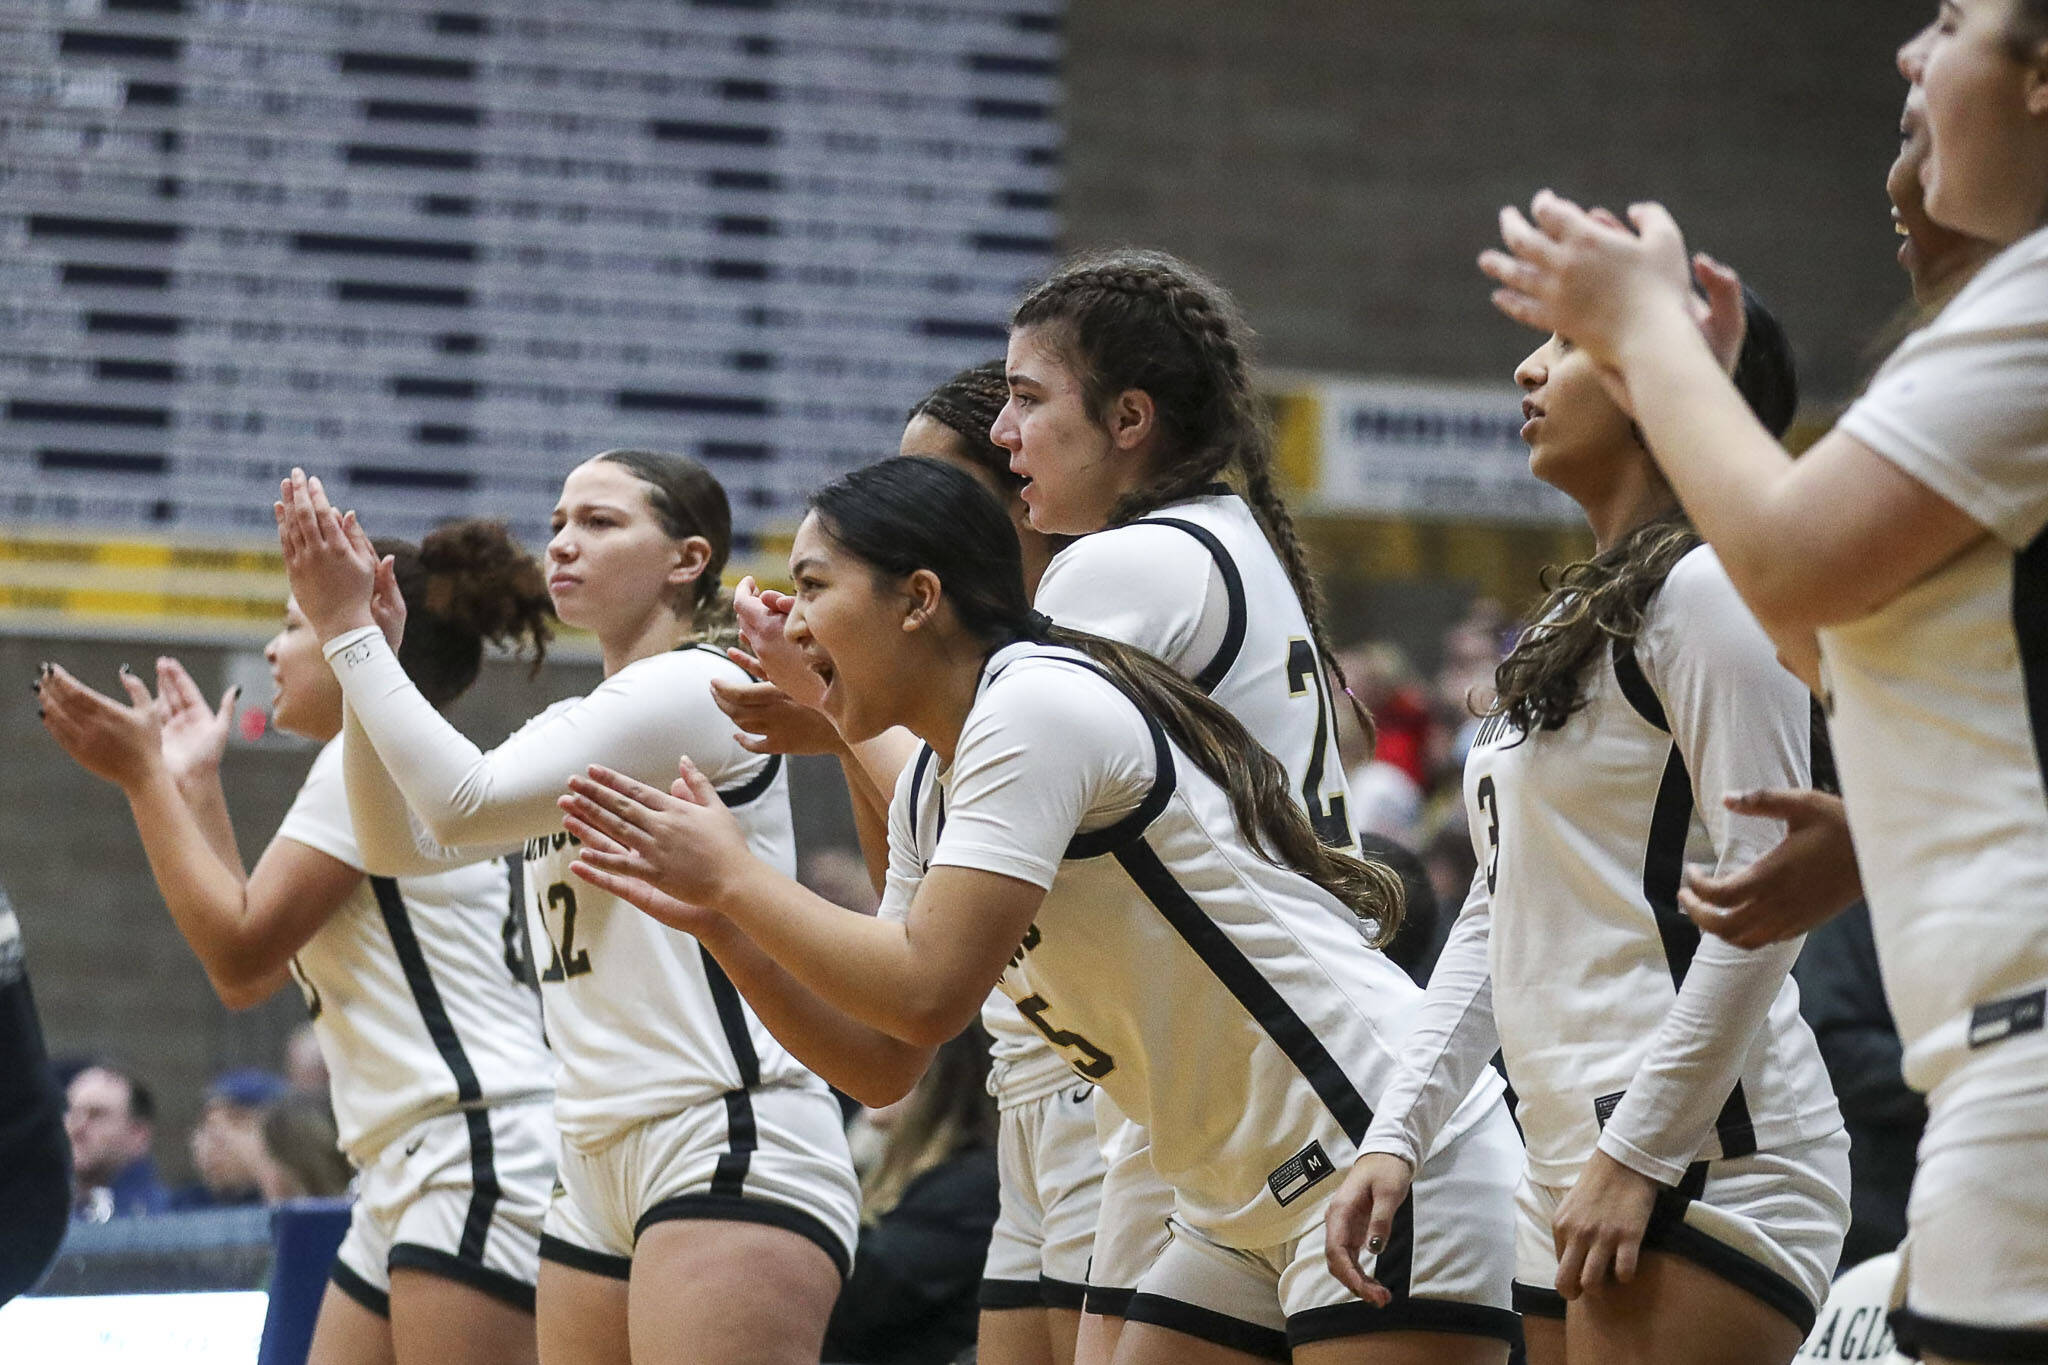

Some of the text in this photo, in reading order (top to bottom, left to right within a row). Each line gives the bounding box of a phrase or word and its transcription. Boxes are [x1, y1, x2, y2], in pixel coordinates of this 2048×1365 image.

[1287, 636, 1356, 850] 2
[1478, 773, 1500, 895] 3
[537, 880, 593, 982] 12
[1015, 991, 1117, 1079] 5
[1307, 1154, 1322, 1171] M
